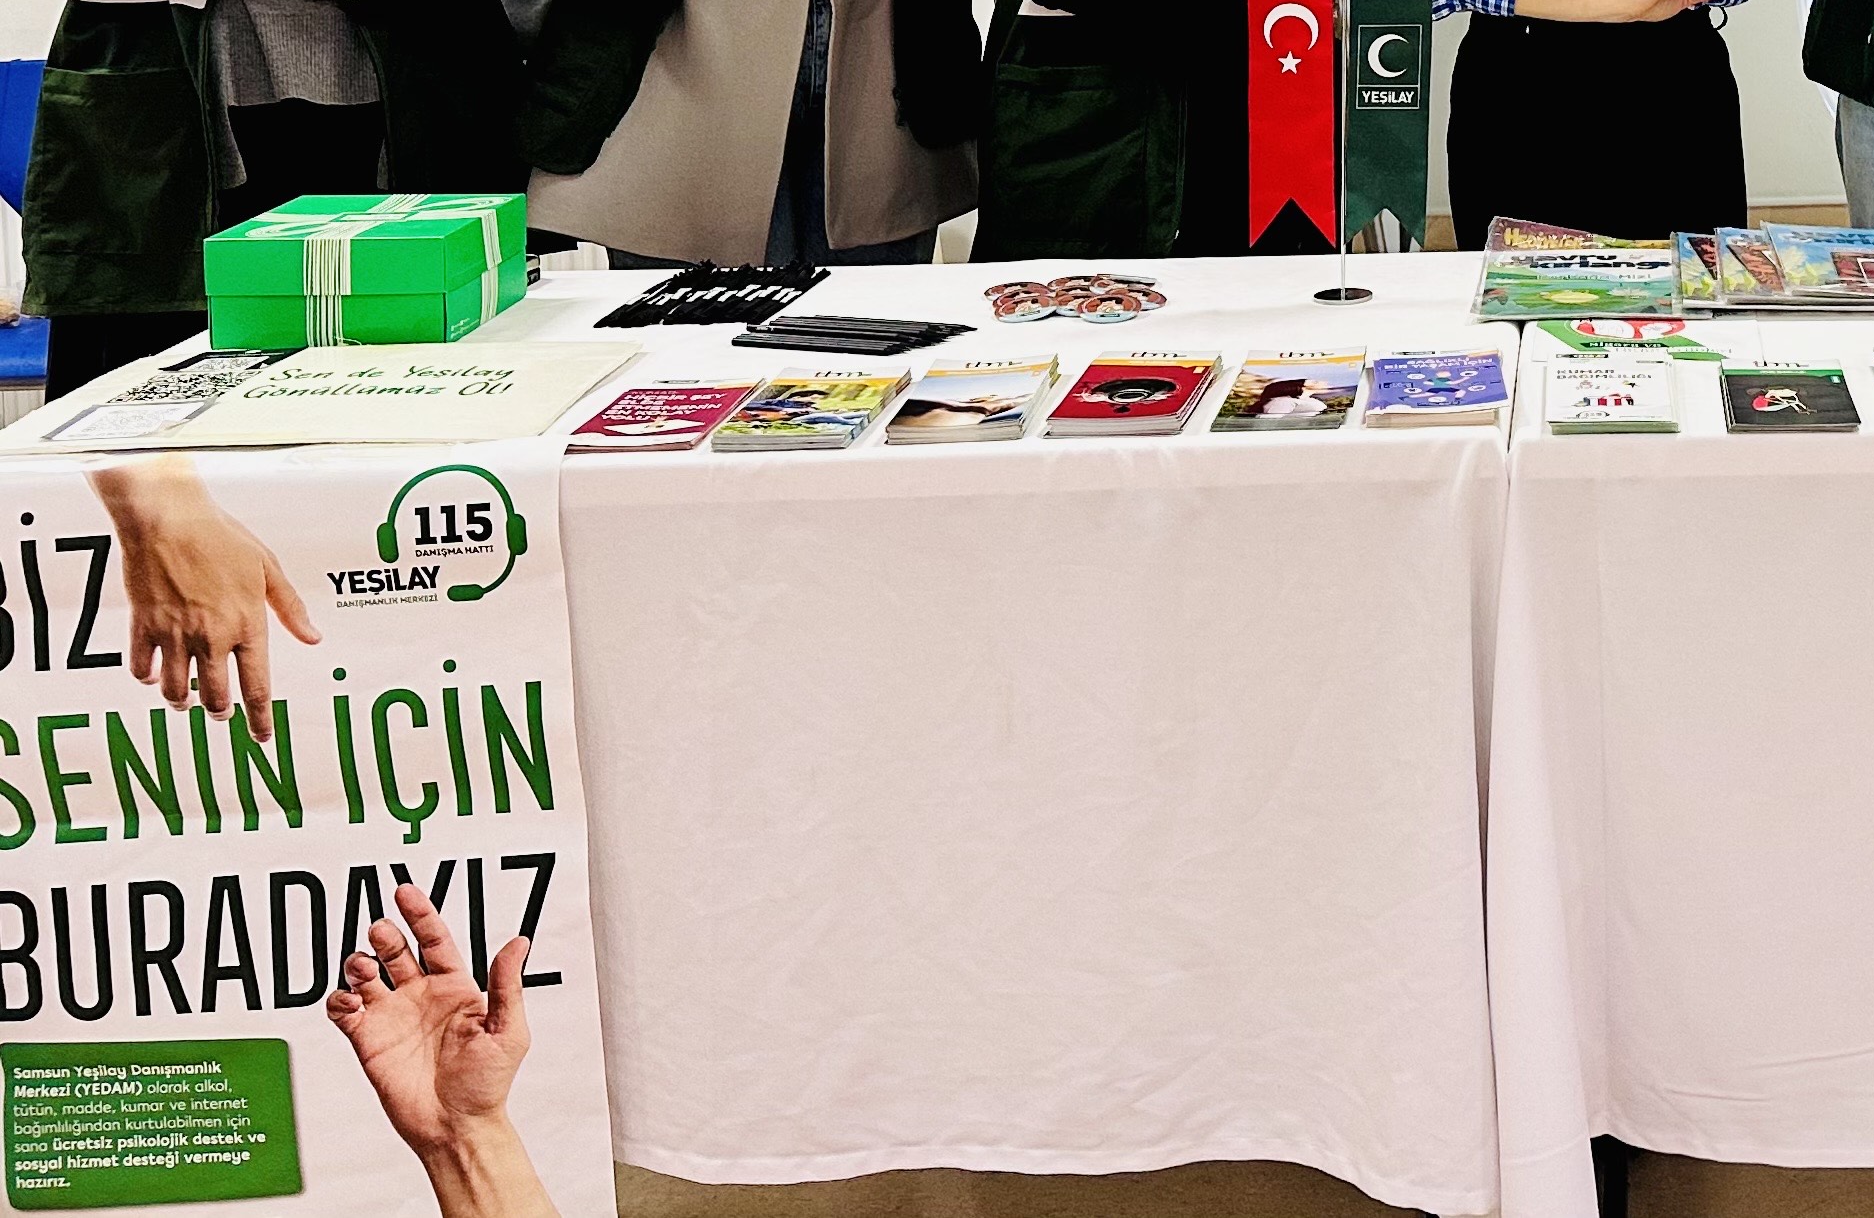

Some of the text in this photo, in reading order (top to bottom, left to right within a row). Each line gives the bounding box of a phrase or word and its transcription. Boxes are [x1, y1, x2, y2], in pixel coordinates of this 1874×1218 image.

[270, 368, 334, 381] Sen
[347, 367, 384, 378] de
[415, 502, 493, 546] 115
[415, 545, 494, 558] DANIŞMA HATTI
[0, 512, 123, 674] İZ
[332, 659, 556, 845] İÇİN
[0, 853, 563, 1023] BURADAYIZ
[13, 1061, 222, 1080] Samsun Yeşilay Danışmanlık
[14, 1079, 233, 1098] Merkezi (YEDAM) olarak alkol,
[13, 1097, 248, 1117] tütün, madde, kumar ve internet
[13, 1114, 251, 1137] bağımlılığından kurtulabilmen için
[14, 1132, 266, 1153] sana ücretsiz psikolojik destek ve
[15, 1150, 251, 1174] sosyal hizmet desteği vermeye
[16, 1176, 71, 1189] hazırız.
